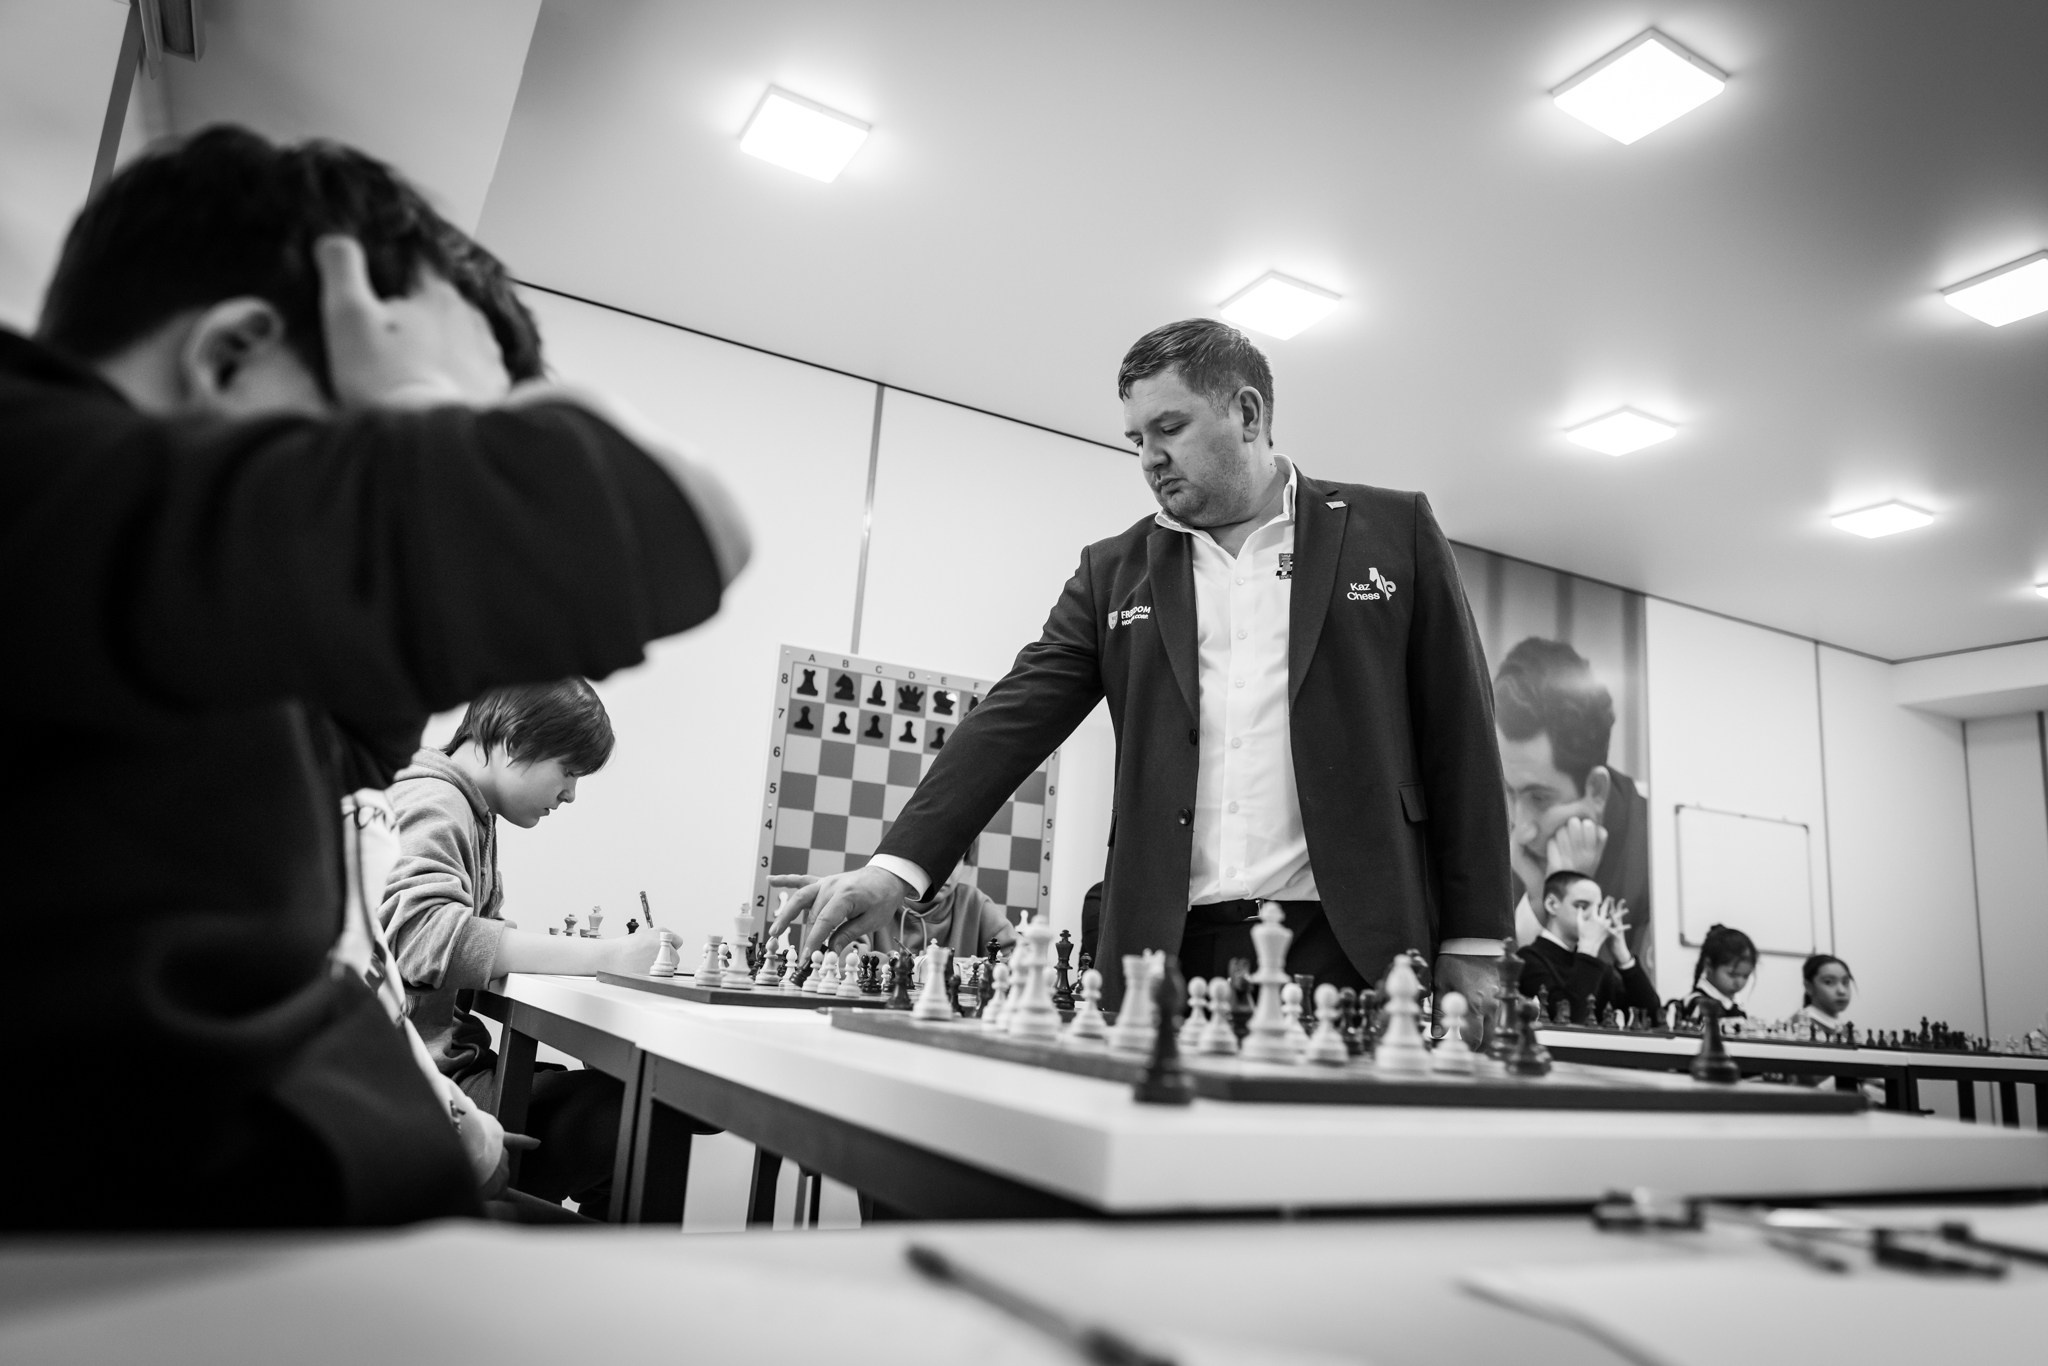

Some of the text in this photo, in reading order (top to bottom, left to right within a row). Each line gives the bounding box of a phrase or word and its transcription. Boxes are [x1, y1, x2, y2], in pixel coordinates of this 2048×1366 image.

[1350, 582, 1371, 591] Kaz
[1346, 591, 1380, 601] Chess
[1121, 605, 1151, 619] FRDOM
[808, 654, 979, 690] A B C D E F
[781, 673, 789, 684] 8
[778, 708, 785, 718] 7
[773, 746, 781, 757] 6
[769, 783, 777, 794] 5
[1048, 785, 1055, 796] 6
[765, 819, 772, 830] 4
[1046, 818, 1053, 829] 5
[1043, 851, 1050, 861] 4
[761, 856, 769, 868] 3
[1041, 885, 1048, 896] 3
[756, 895, 765, 907] 2
